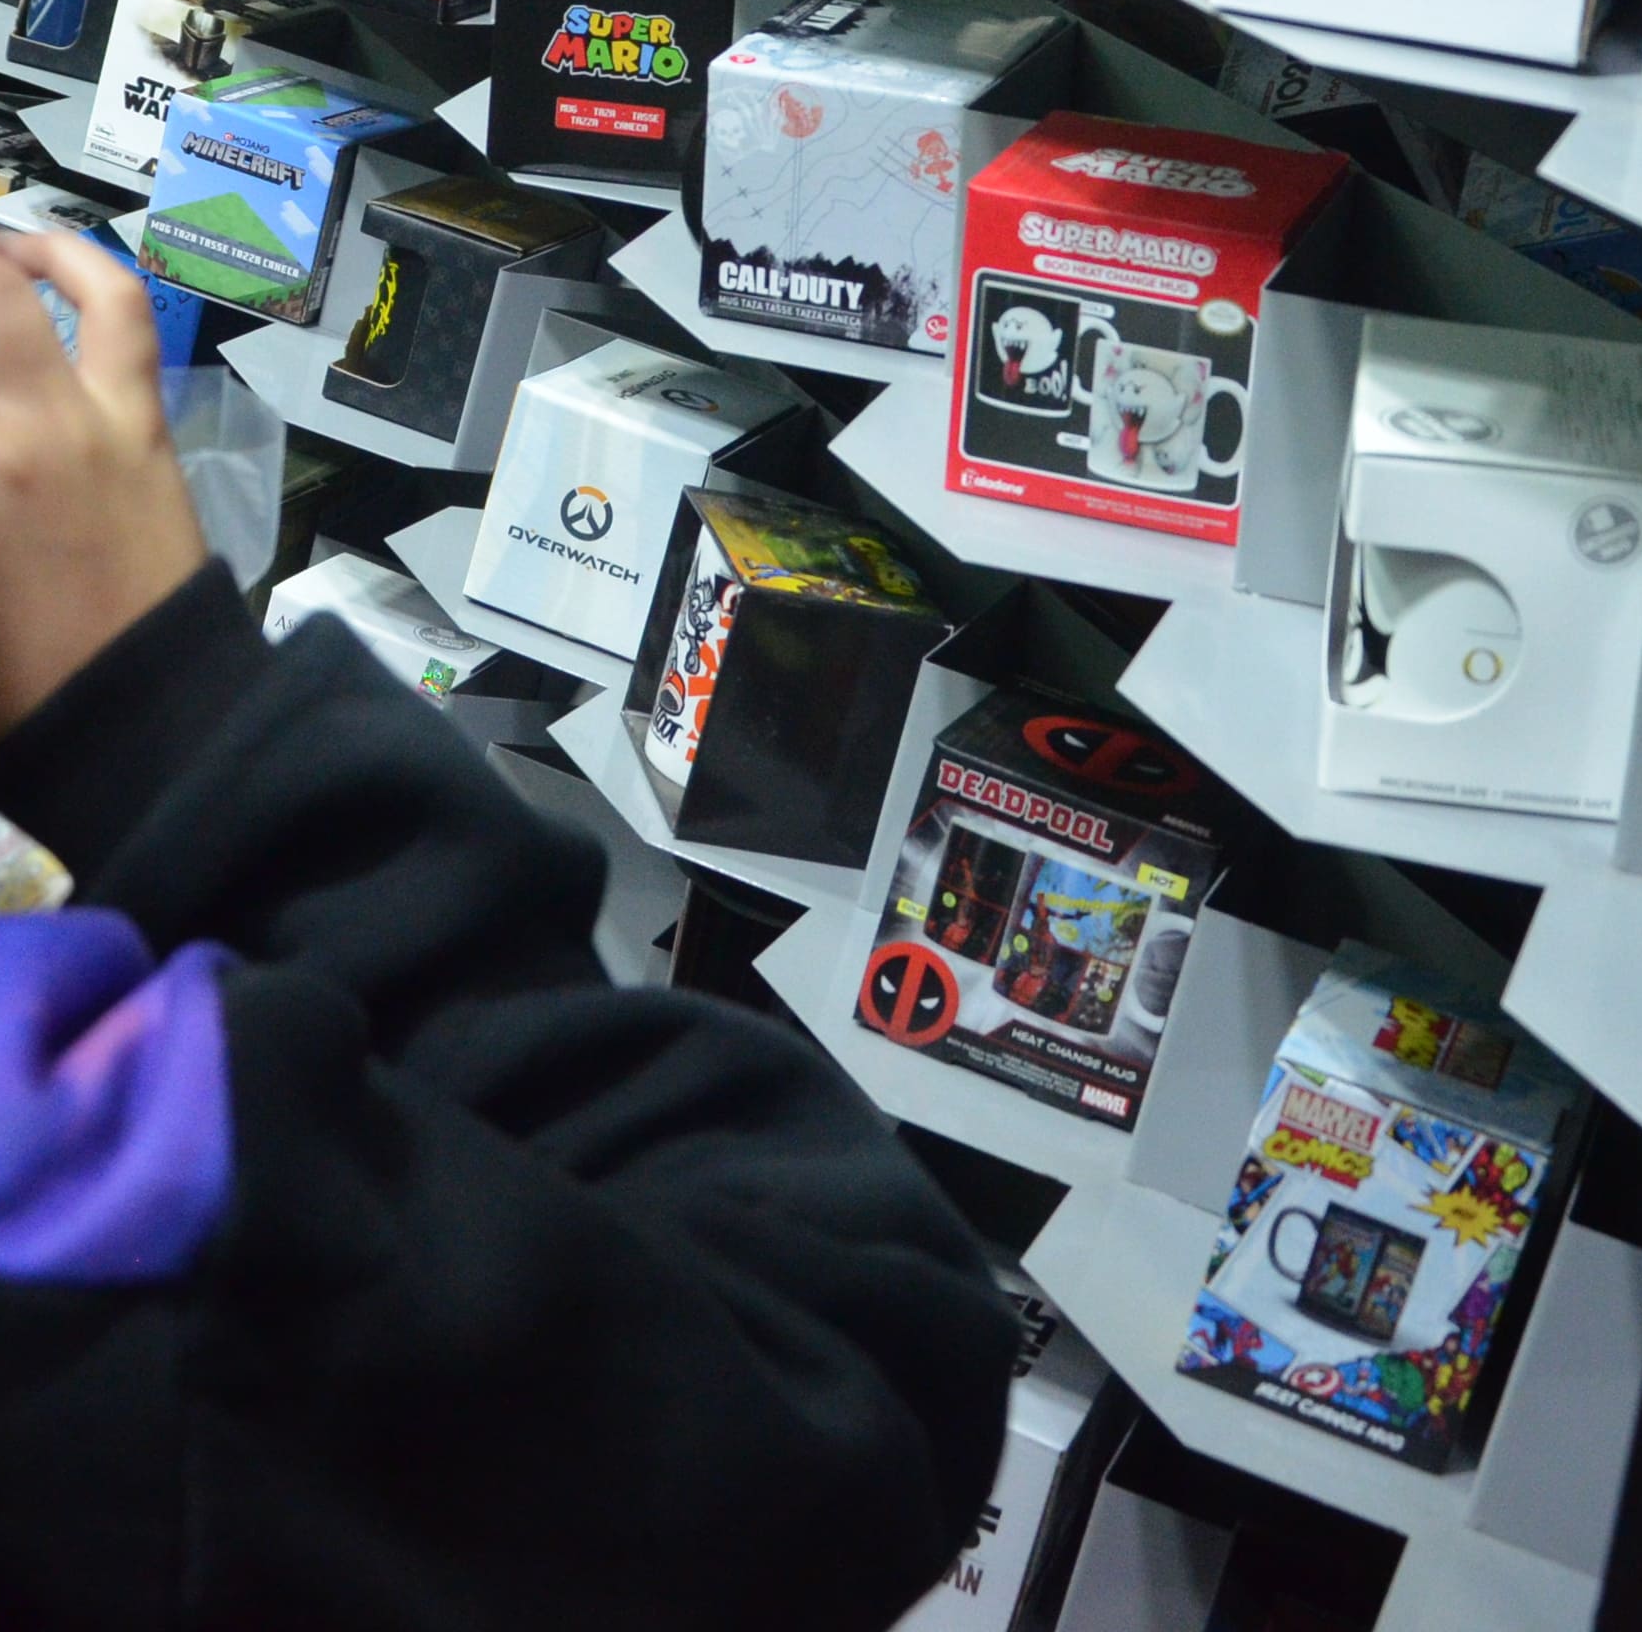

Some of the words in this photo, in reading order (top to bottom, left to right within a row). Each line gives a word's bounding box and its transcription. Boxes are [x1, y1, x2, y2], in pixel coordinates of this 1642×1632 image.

[563, 5, 675, 45] SUPER
[542, 29, 688, 86] MARIO
[125, 76, 176, 101] STA
[559, 103, 578, 115] MUG
[593, 106, 617, 118] TAZA
[632, 111, 660, 124] TASSE
[570, 116, 599, 128] TAZZA
[180, 130, 306, 192] MINECRAFT
[1050, 152, 1257, 198] MARIO
[150, 220, 172, 236] MUG
[198, 234, 229, 255] TASSE
[262, 255, 300, 279] CANECA
[1018, 212, 1116, 259] SUPER
[1118, 229, 1218, 278] MARIO
[718, 261, 782, 298] CALL
[788, 272, 864, 311] DUTY
[1042, 259, 1072, 273] BOO
[1073, 264, 1103, 279] HEAT
[1104, 269, 1157, 289] CHANGE
[1158, 278, 1191, 294] MUG
[718, 295, 739, 307] MUG
[741, 298, 763, 311] TAZA
[765, 302, 793, 317] TASSE
[795, 307, 824, 322] TAZZA
[825, 312, 861, 327] CANECA
[507, 524, 641, 586] OVERWATCH
[937, 759, 1113, 853] DEADPOOL
[1149, 871, 1176, 889] HOT
[1011, 1026, 1045, 1049] HEAT
[1046, 1041, 1102, 1071] CHANGE
[1103, 1064, 1137, 1082] MUG
[1081, 1083, 1130, 1118] MARVEL
[1281, 1086, 1380, 1149] MARVEL
[1262, 1129, 1374, 1182] COMICS
[1254, 1381, 1297, 1409] HEAT
